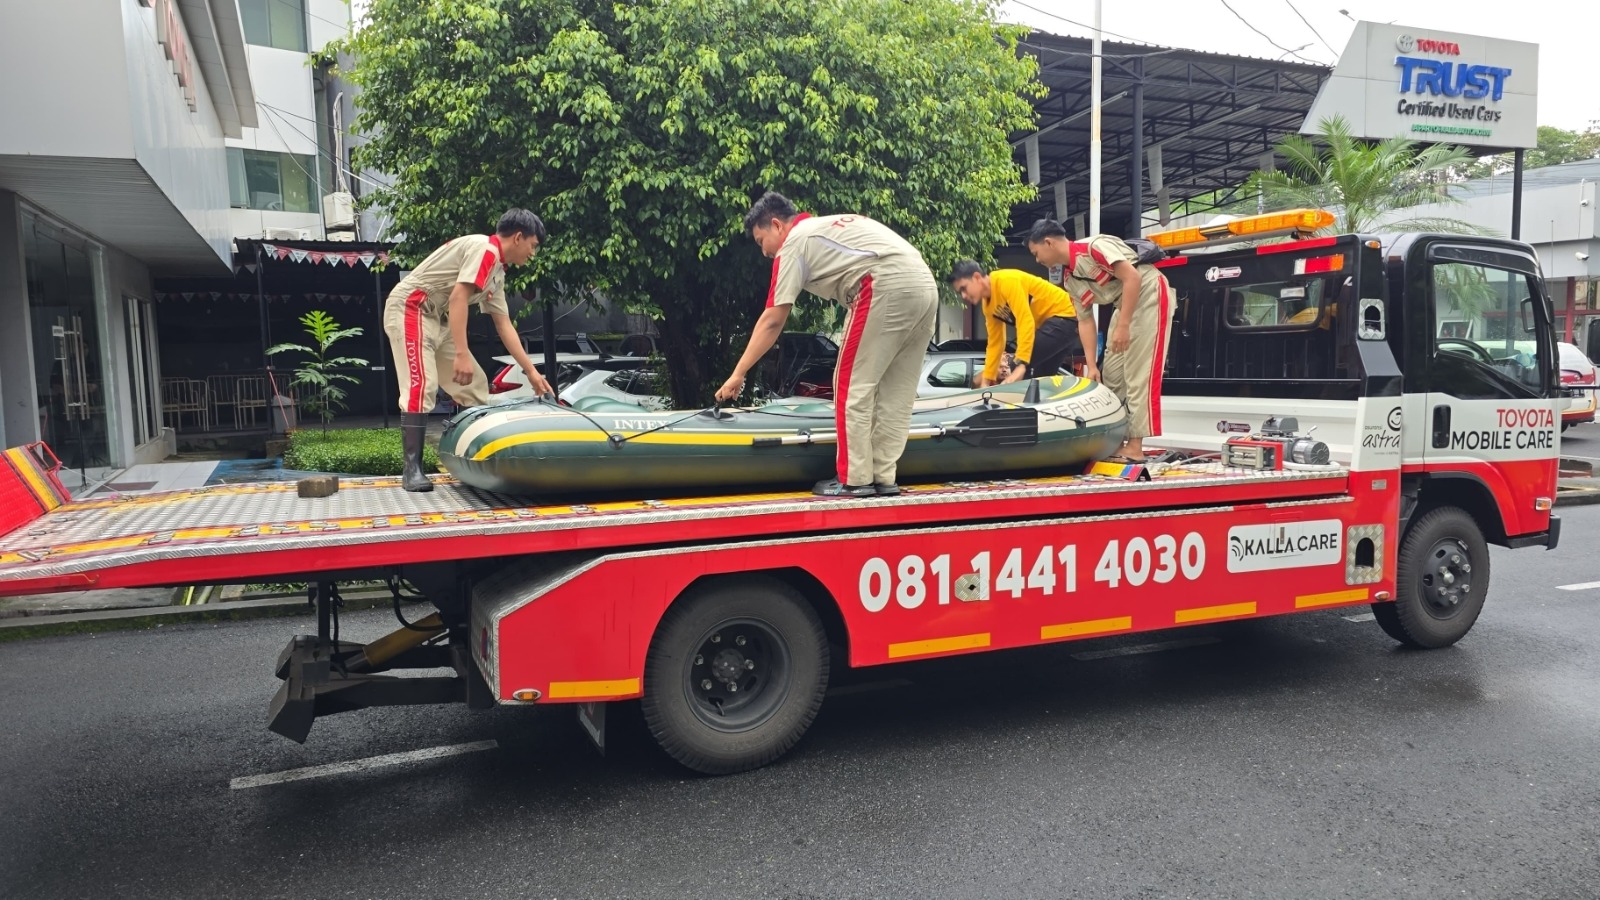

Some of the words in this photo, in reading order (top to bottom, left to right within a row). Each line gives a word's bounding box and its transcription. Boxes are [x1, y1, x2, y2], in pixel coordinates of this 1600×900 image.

[1416, 38, 1460, 56] TOYOTA
[1395, 56, 1512, 102] TRUST
[1397, 98, 1446, 118] Certified
[1447, 102, 1475, 120] Used
[1476, 105, 1502, 122] Cars
[406, 340, 420, 388] TOYOTA
[613, 419, 671, 431] INTEX
[1496, 408, 1554, 428] TOYOTA
[1362, 429, 1401, 449] astra
[1451, 430, 1512, 451] MOBILE
[1516, 430, 1554, 449] CARE
[1244, 536, 1295, 557] KALLA
[1297, 532, 1338, 552] CARE
[858, 554, 951, 613] 081
[970, 544, 1077, 601] 1441
[1094, 531, 1206, 588] 4030
